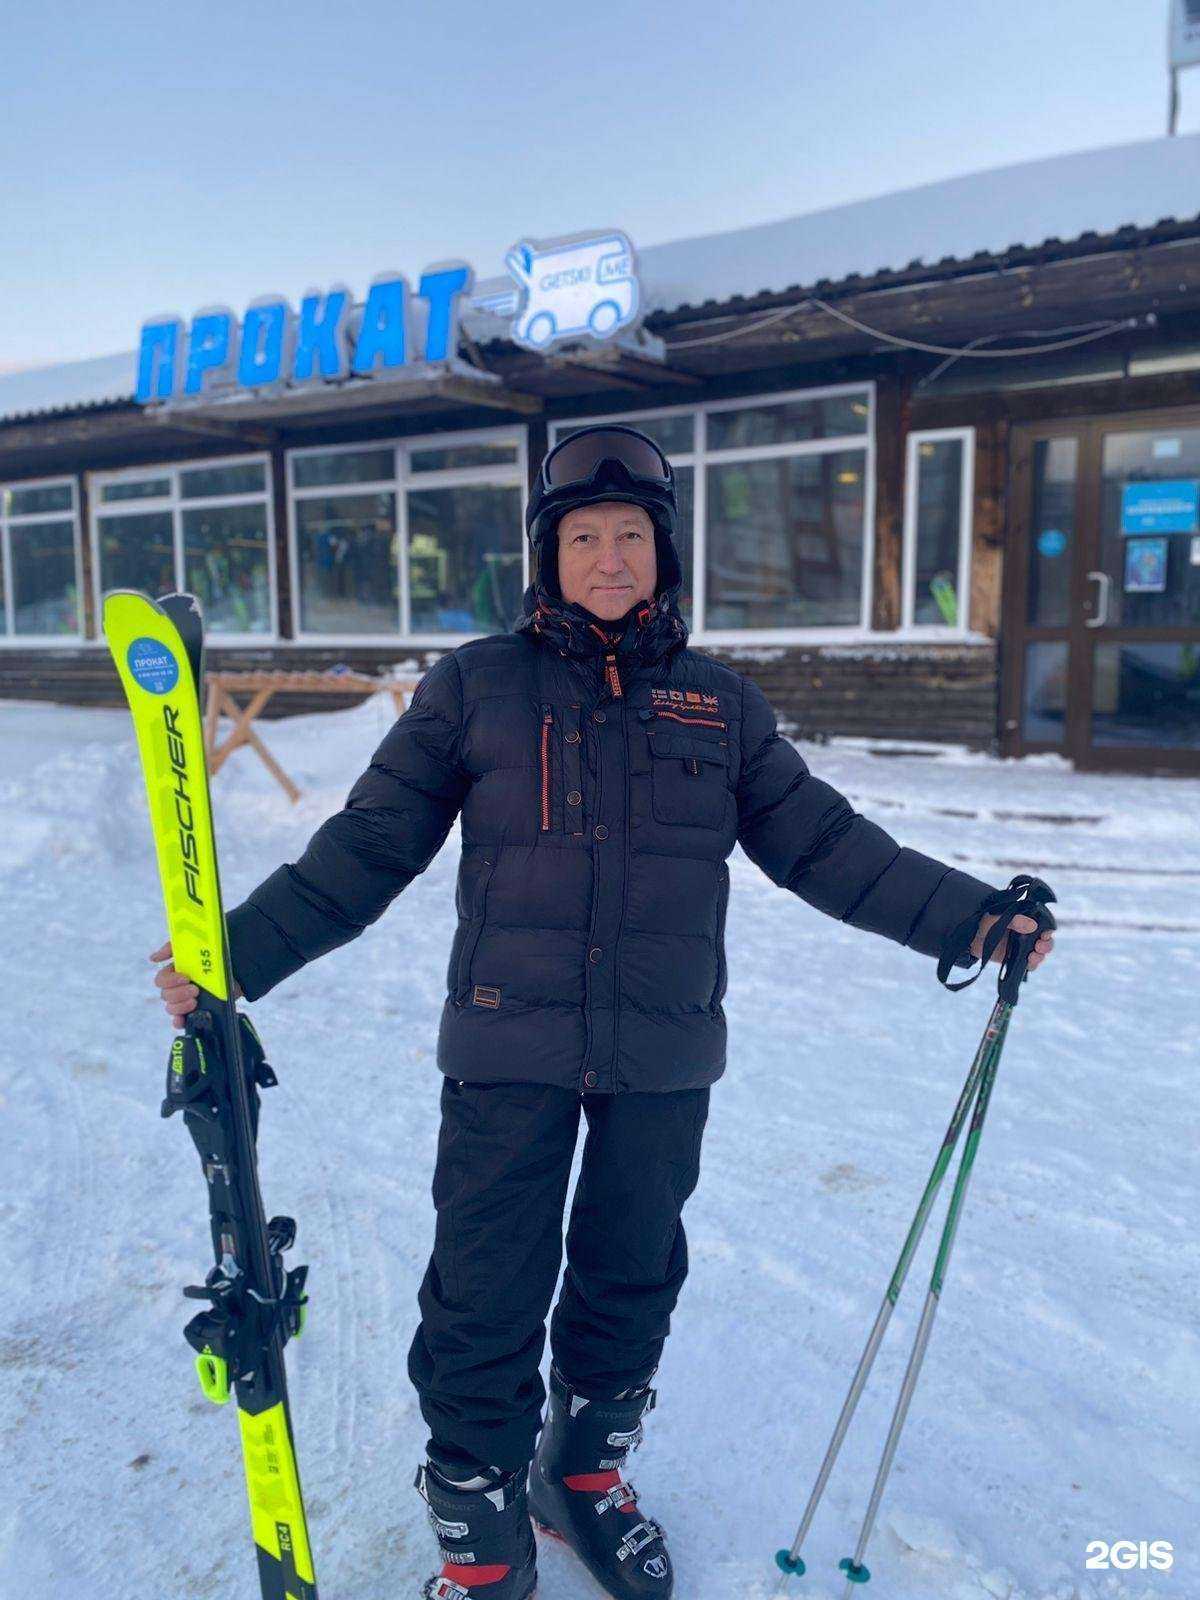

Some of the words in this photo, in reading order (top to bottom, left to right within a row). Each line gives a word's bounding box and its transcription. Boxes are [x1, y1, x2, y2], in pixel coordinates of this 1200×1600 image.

[135, 265, 471, 402] ПРОКАТ
[134, 656, 168, 668] ПРОКАТ
[163, 704, 204, 907] FISCHER
[201, 949, 211, 976] 155
[278, 1525, 292, 1551] RC4
